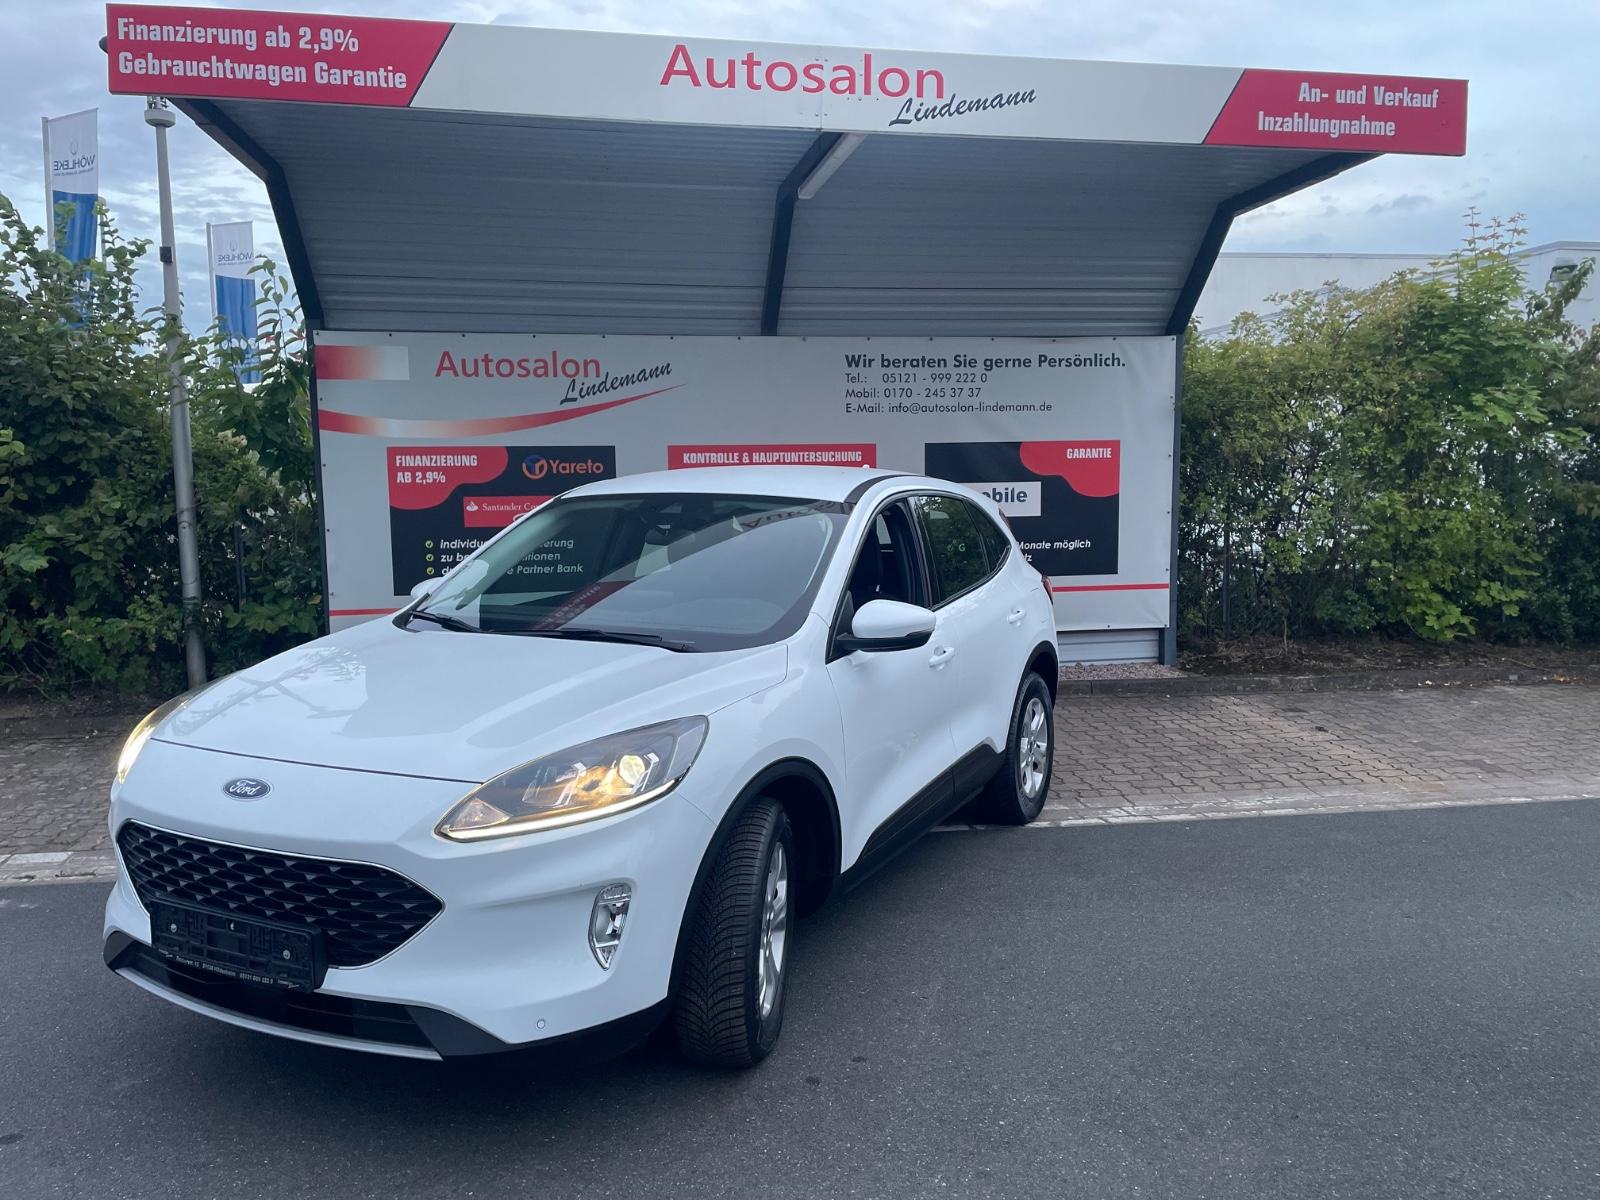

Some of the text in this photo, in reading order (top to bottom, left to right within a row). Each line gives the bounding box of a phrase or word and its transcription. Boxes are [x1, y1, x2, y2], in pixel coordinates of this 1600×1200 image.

[117, 18, 359, 53] Finanzierung ab 2,9%
[118, 51, 407, 89] Gebrauchtwagen Garantie
[659, 44, 945, 99] Autosalon
[1298, 82, 1439, 108] An- und Verkauf
[888, 88, 1037, 127] Lindemann
[1257, 111, 1396, 138] Inzahlungnahme
[435, 351, 601, 378] Autosalon
[845, 353, 1126, 372] Wir beraten Sie gerne Persönlich.
[560, 362, 673, 406] Lindemann
[845, 373, 868, 384] Tel.:
[882, 373, 917, 383] 05121
[930, 373, 952, 383] 999
[955, 373, 977, 383] 222
[980, 372, 988, 383] 0
[845, 387, 880, 399] Mobil:
[884, 387, 913, 398] 0170
[924, 387, 946, 398] 245
[950, 387, 964, 398] 37
[967, 387, 982, 398] 37
[845, 401, 1053, 414] E-Mail: info@autosalon-lindemann.de
[683, 451, 862, 464] KONTROLLE & HAUPTUNTERSUCHUNG
[1067, 448, 1112, 459] GARANTIE
[396, 455, 478, 467] FINANZIERUNG
[549, 459, 604, 474] Yareto
[397, 471, 446, 484] AB 2,9%
[982, 487, 1028, 503] bile
[482, 502, 522, 511] Santander
[440, 539, 575, 549] individu erung
[1054, 539, 1091, 550] möglich
[440, 554, 454, 562] zu
[517, 564, 554, 574] Partner
[557, 563, 584, 573] Bank
[229, 780, 261, 795] Ford
